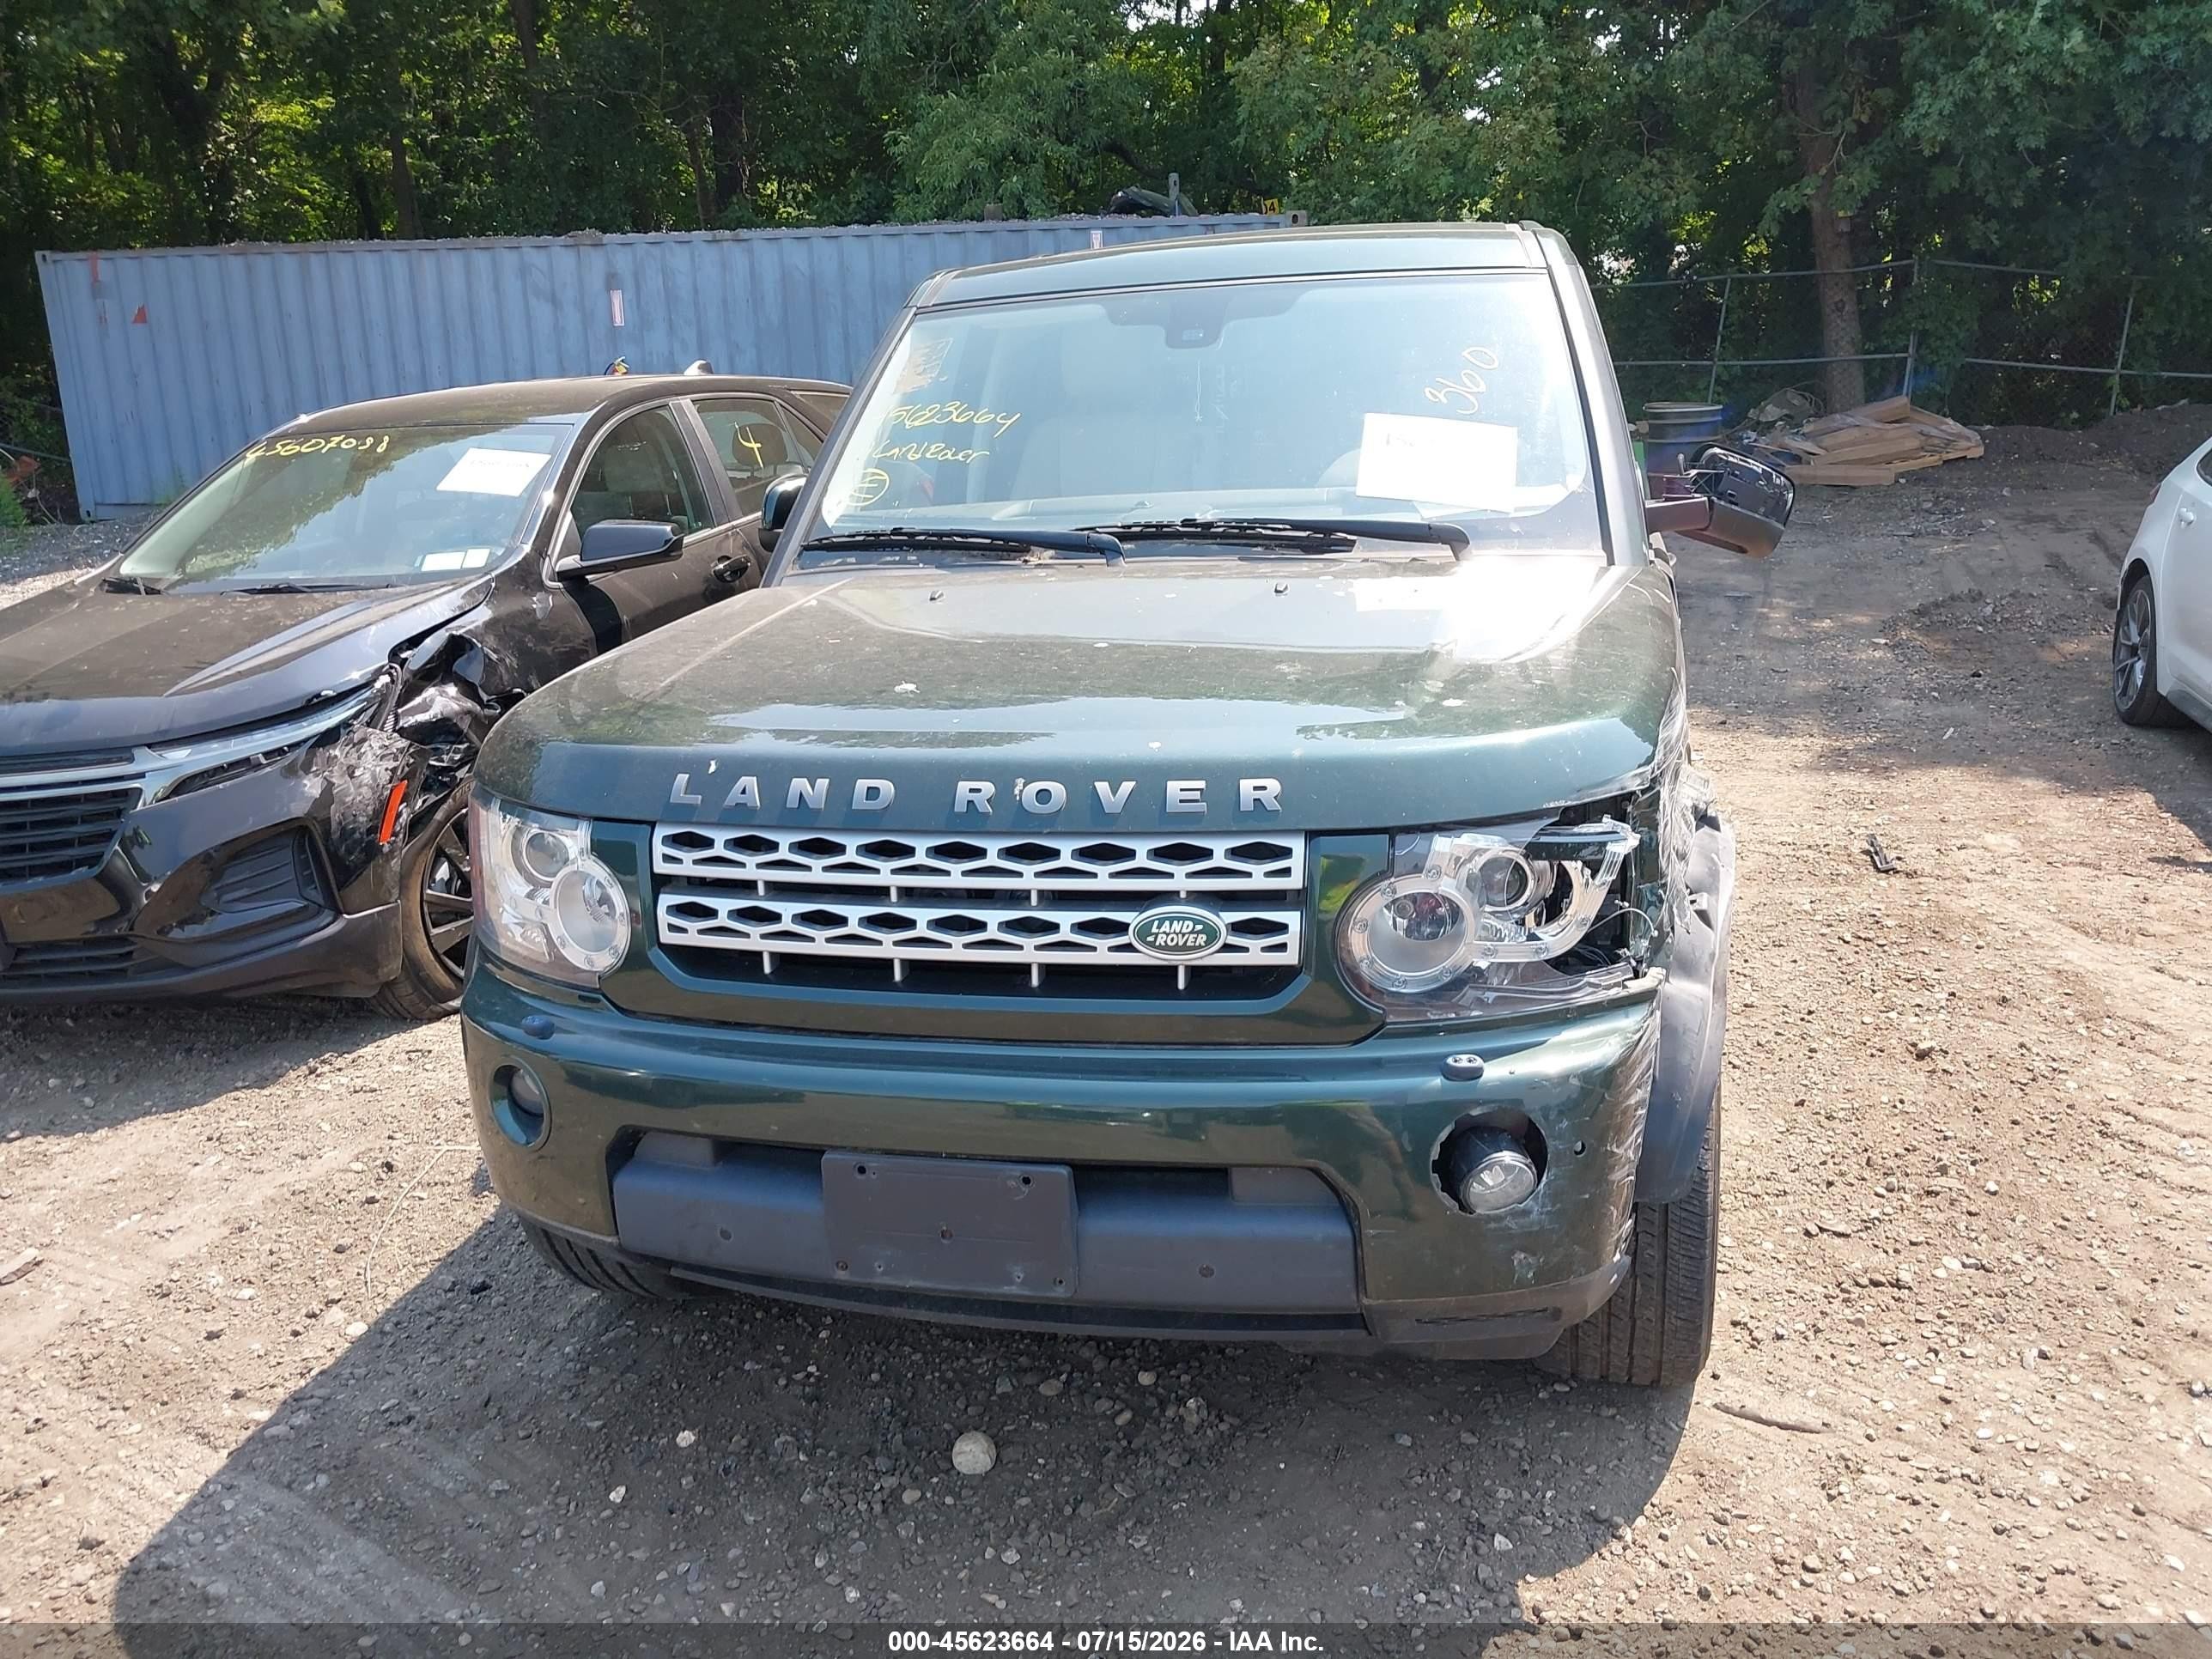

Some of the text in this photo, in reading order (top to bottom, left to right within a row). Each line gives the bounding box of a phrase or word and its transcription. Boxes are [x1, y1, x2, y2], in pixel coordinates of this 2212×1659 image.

[1425, 346, 1498, 414] 360
[881, 400, 1021, 439] 5623664
[669, 773, 1283, 815] LAND ROVER
[1151, 920, 1194, 933] LAND
[1155, 933, 1207, 947] ROVER
